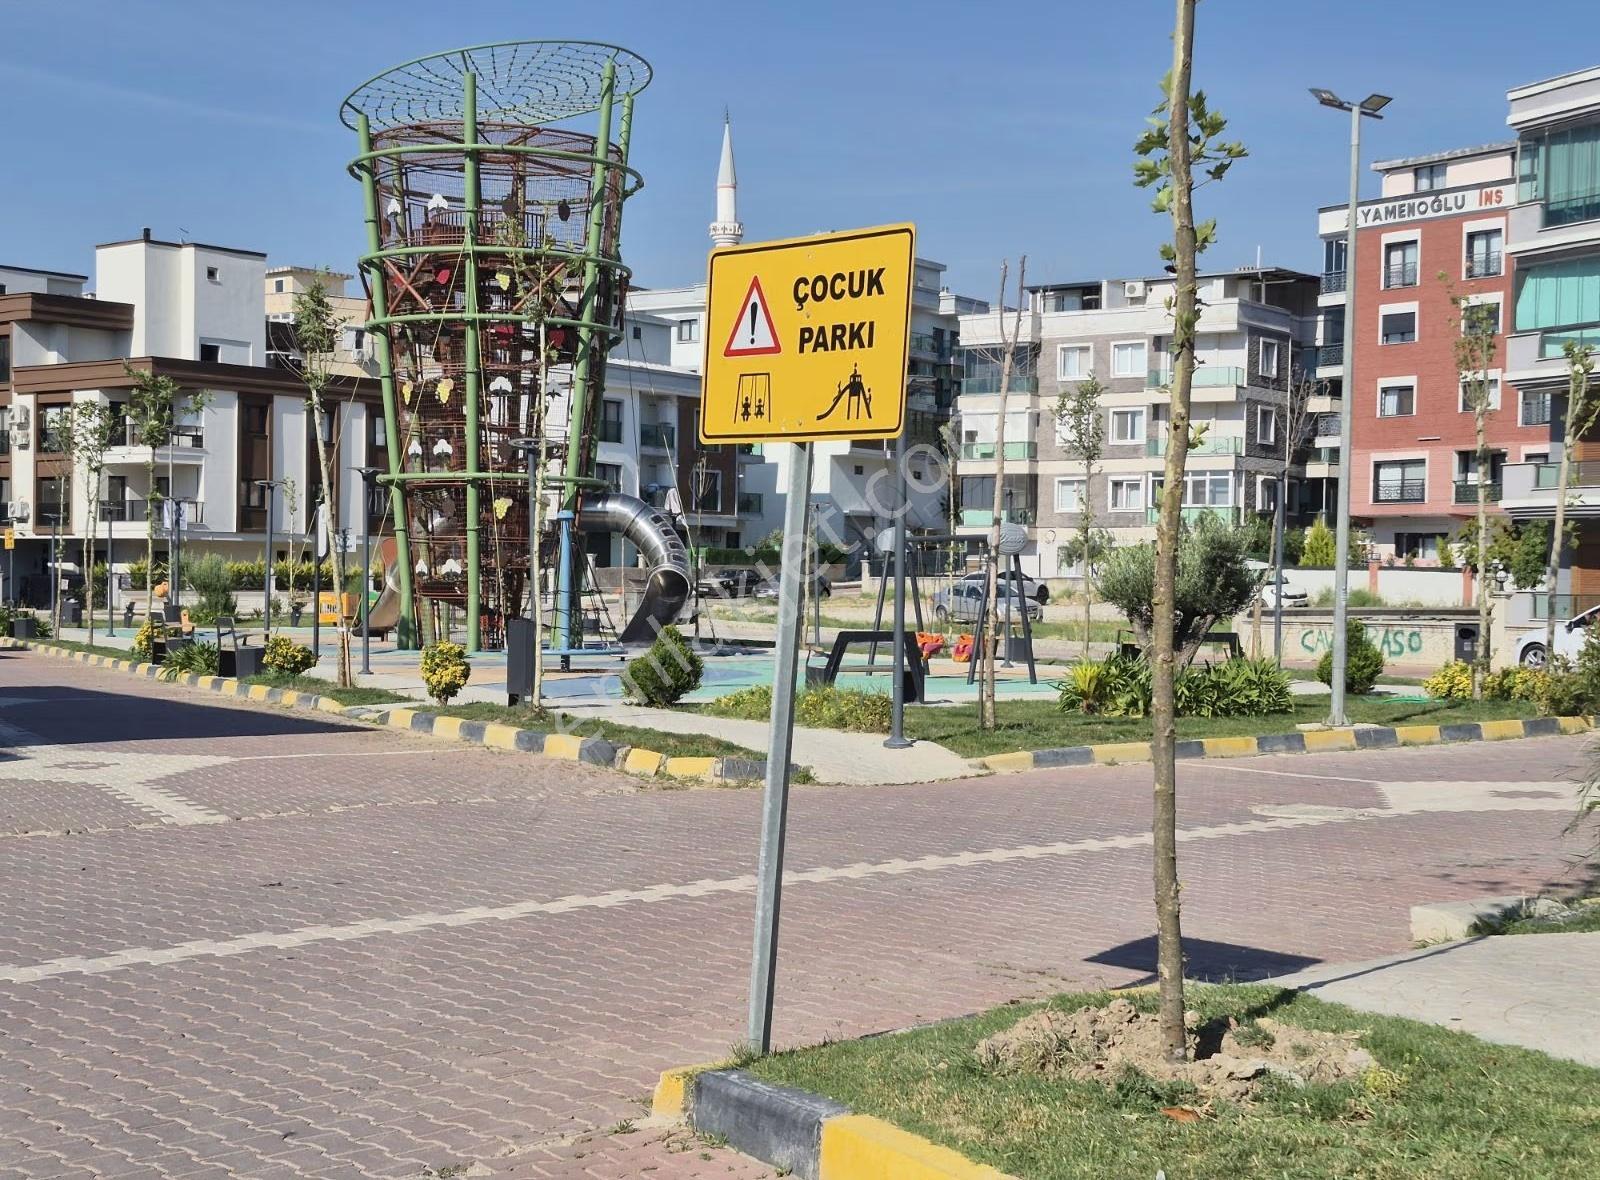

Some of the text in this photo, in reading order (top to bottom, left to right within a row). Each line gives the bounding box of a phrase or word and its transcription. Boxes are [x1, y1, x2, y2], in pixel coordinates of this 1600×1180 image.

[1361, 194, 1466, 224] YAMENOĞLU
[793, 267, 886, 311] ÇOCUK
[798, 320, 875, 354] PARKI
